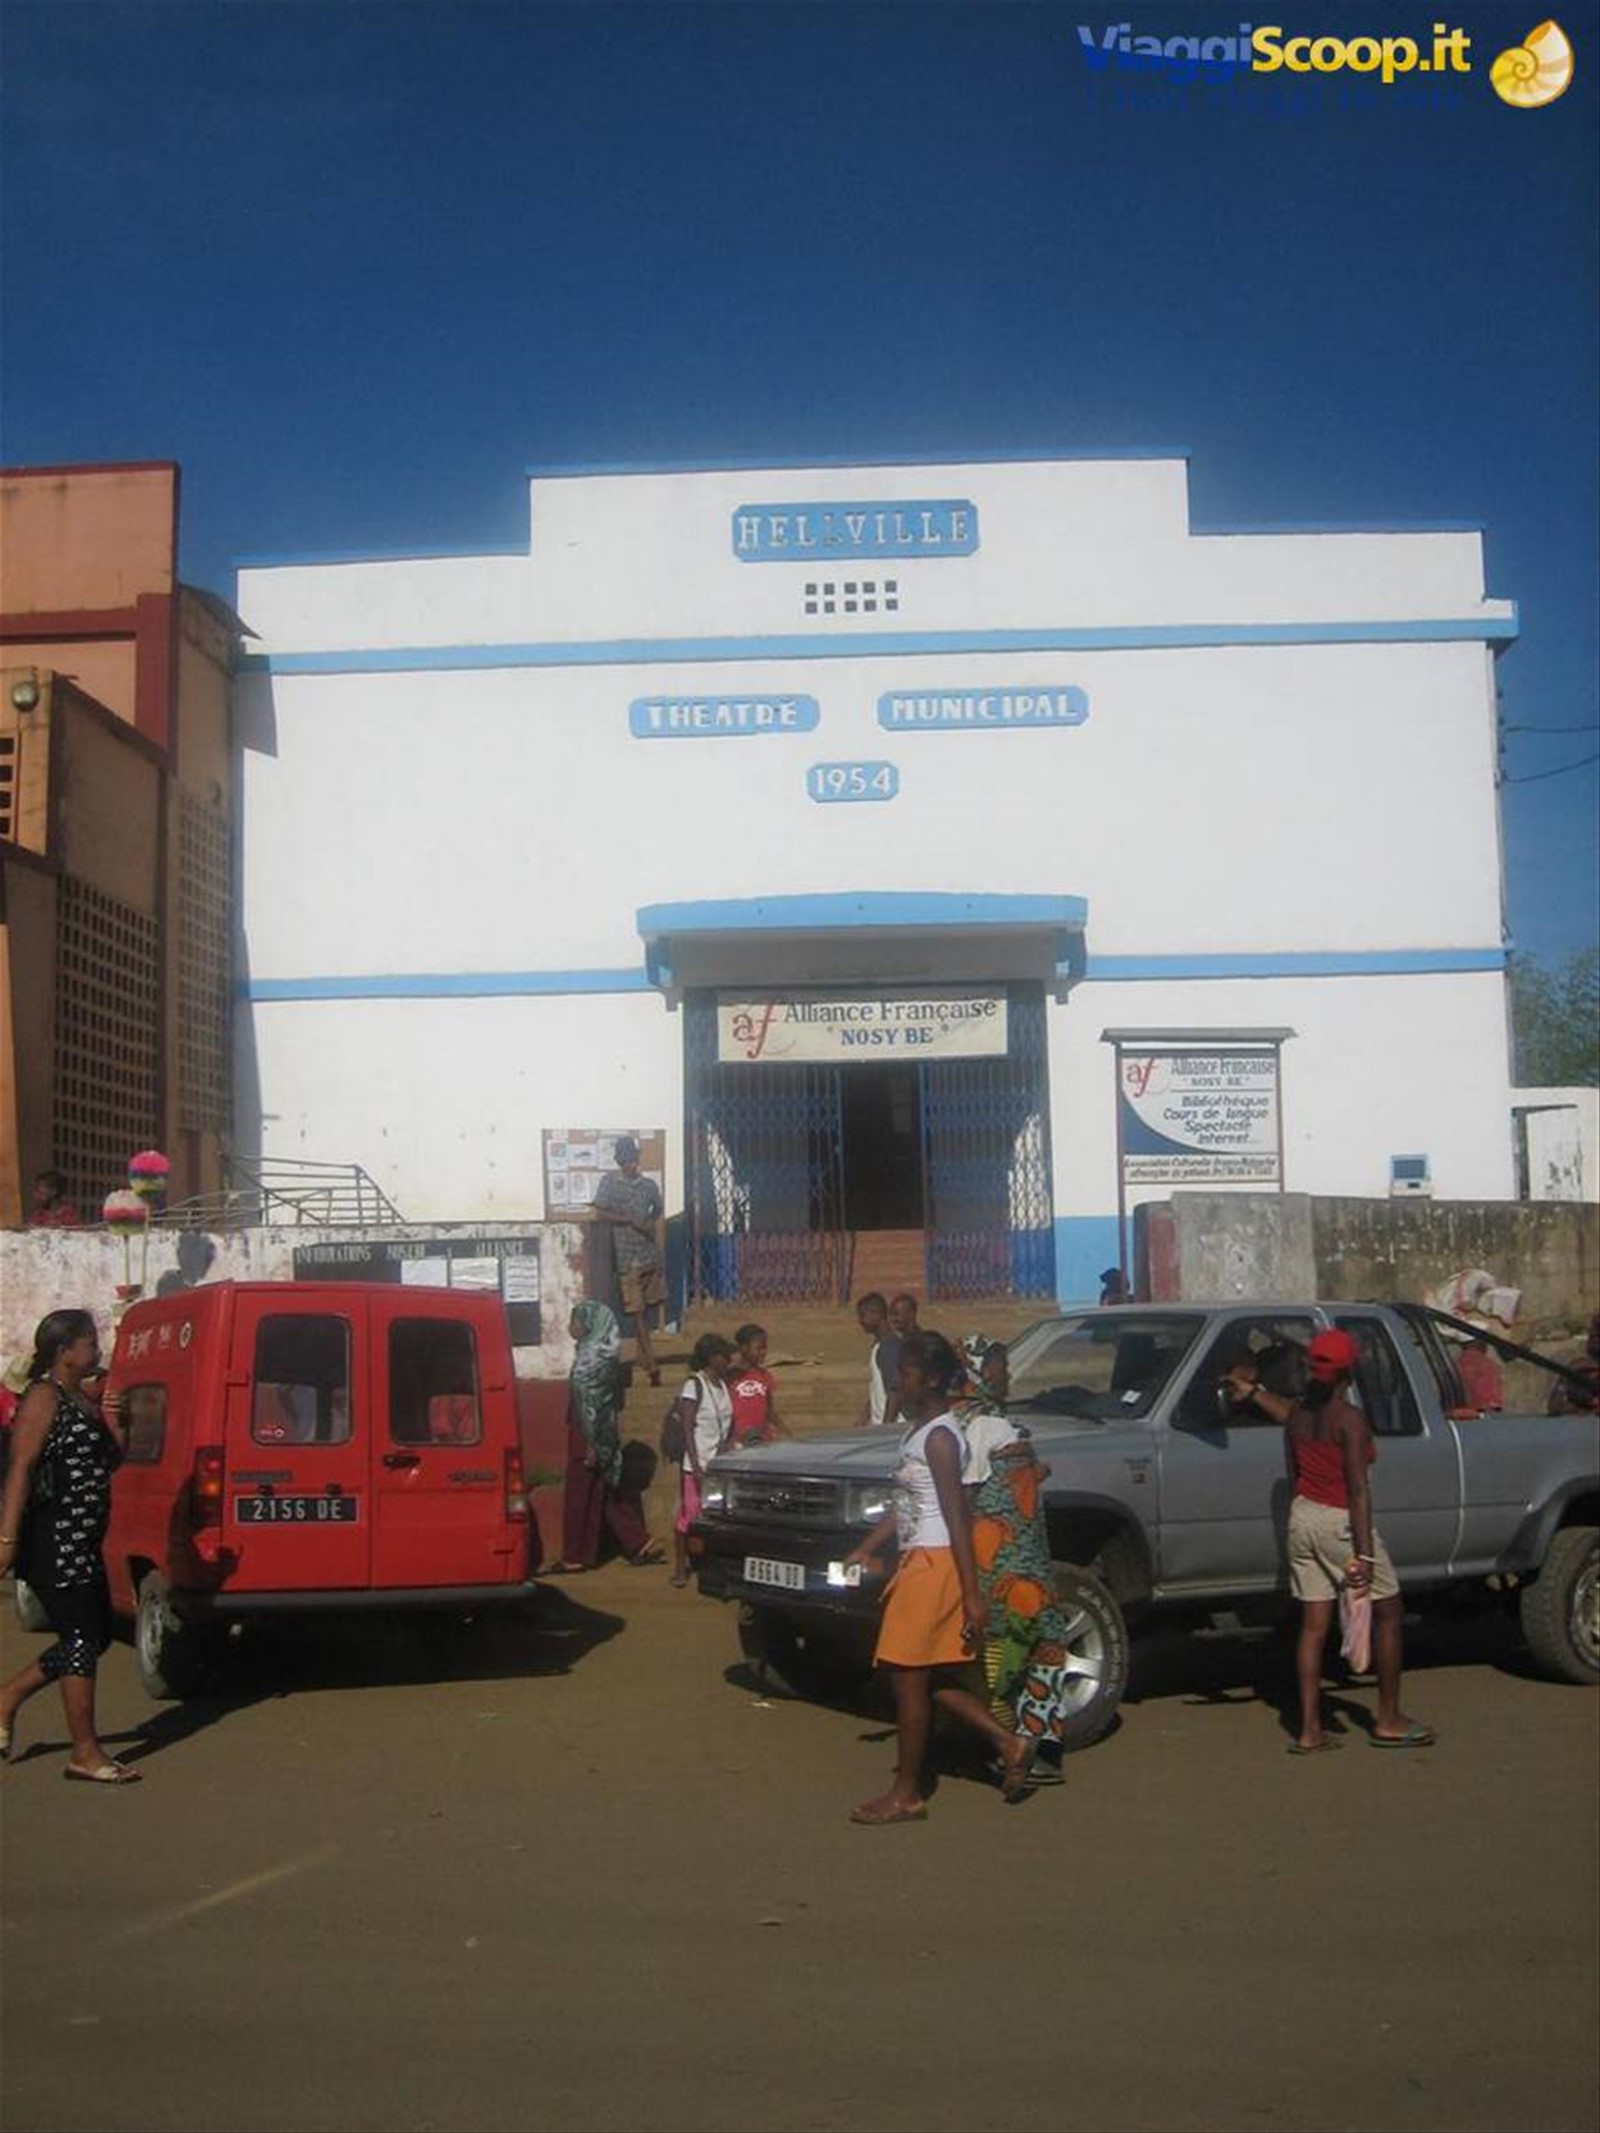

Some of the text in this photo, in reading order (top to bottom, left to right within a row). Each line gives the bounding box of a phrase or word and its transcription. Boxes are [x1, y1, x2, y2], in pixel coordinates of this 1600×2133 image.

[738, 511, 968, 549] HELLVILLE
[892, 694, 1078, 721] MUNICIPAL
[814, 768, 892, 795] 1954
[783, 999, 997, 1023] Alliance Française
[1163, 1108, 1198, 1120] Cours
[1202, 1108, 1220, 1119] de
[253, 1501, 306, 1520] 2156
